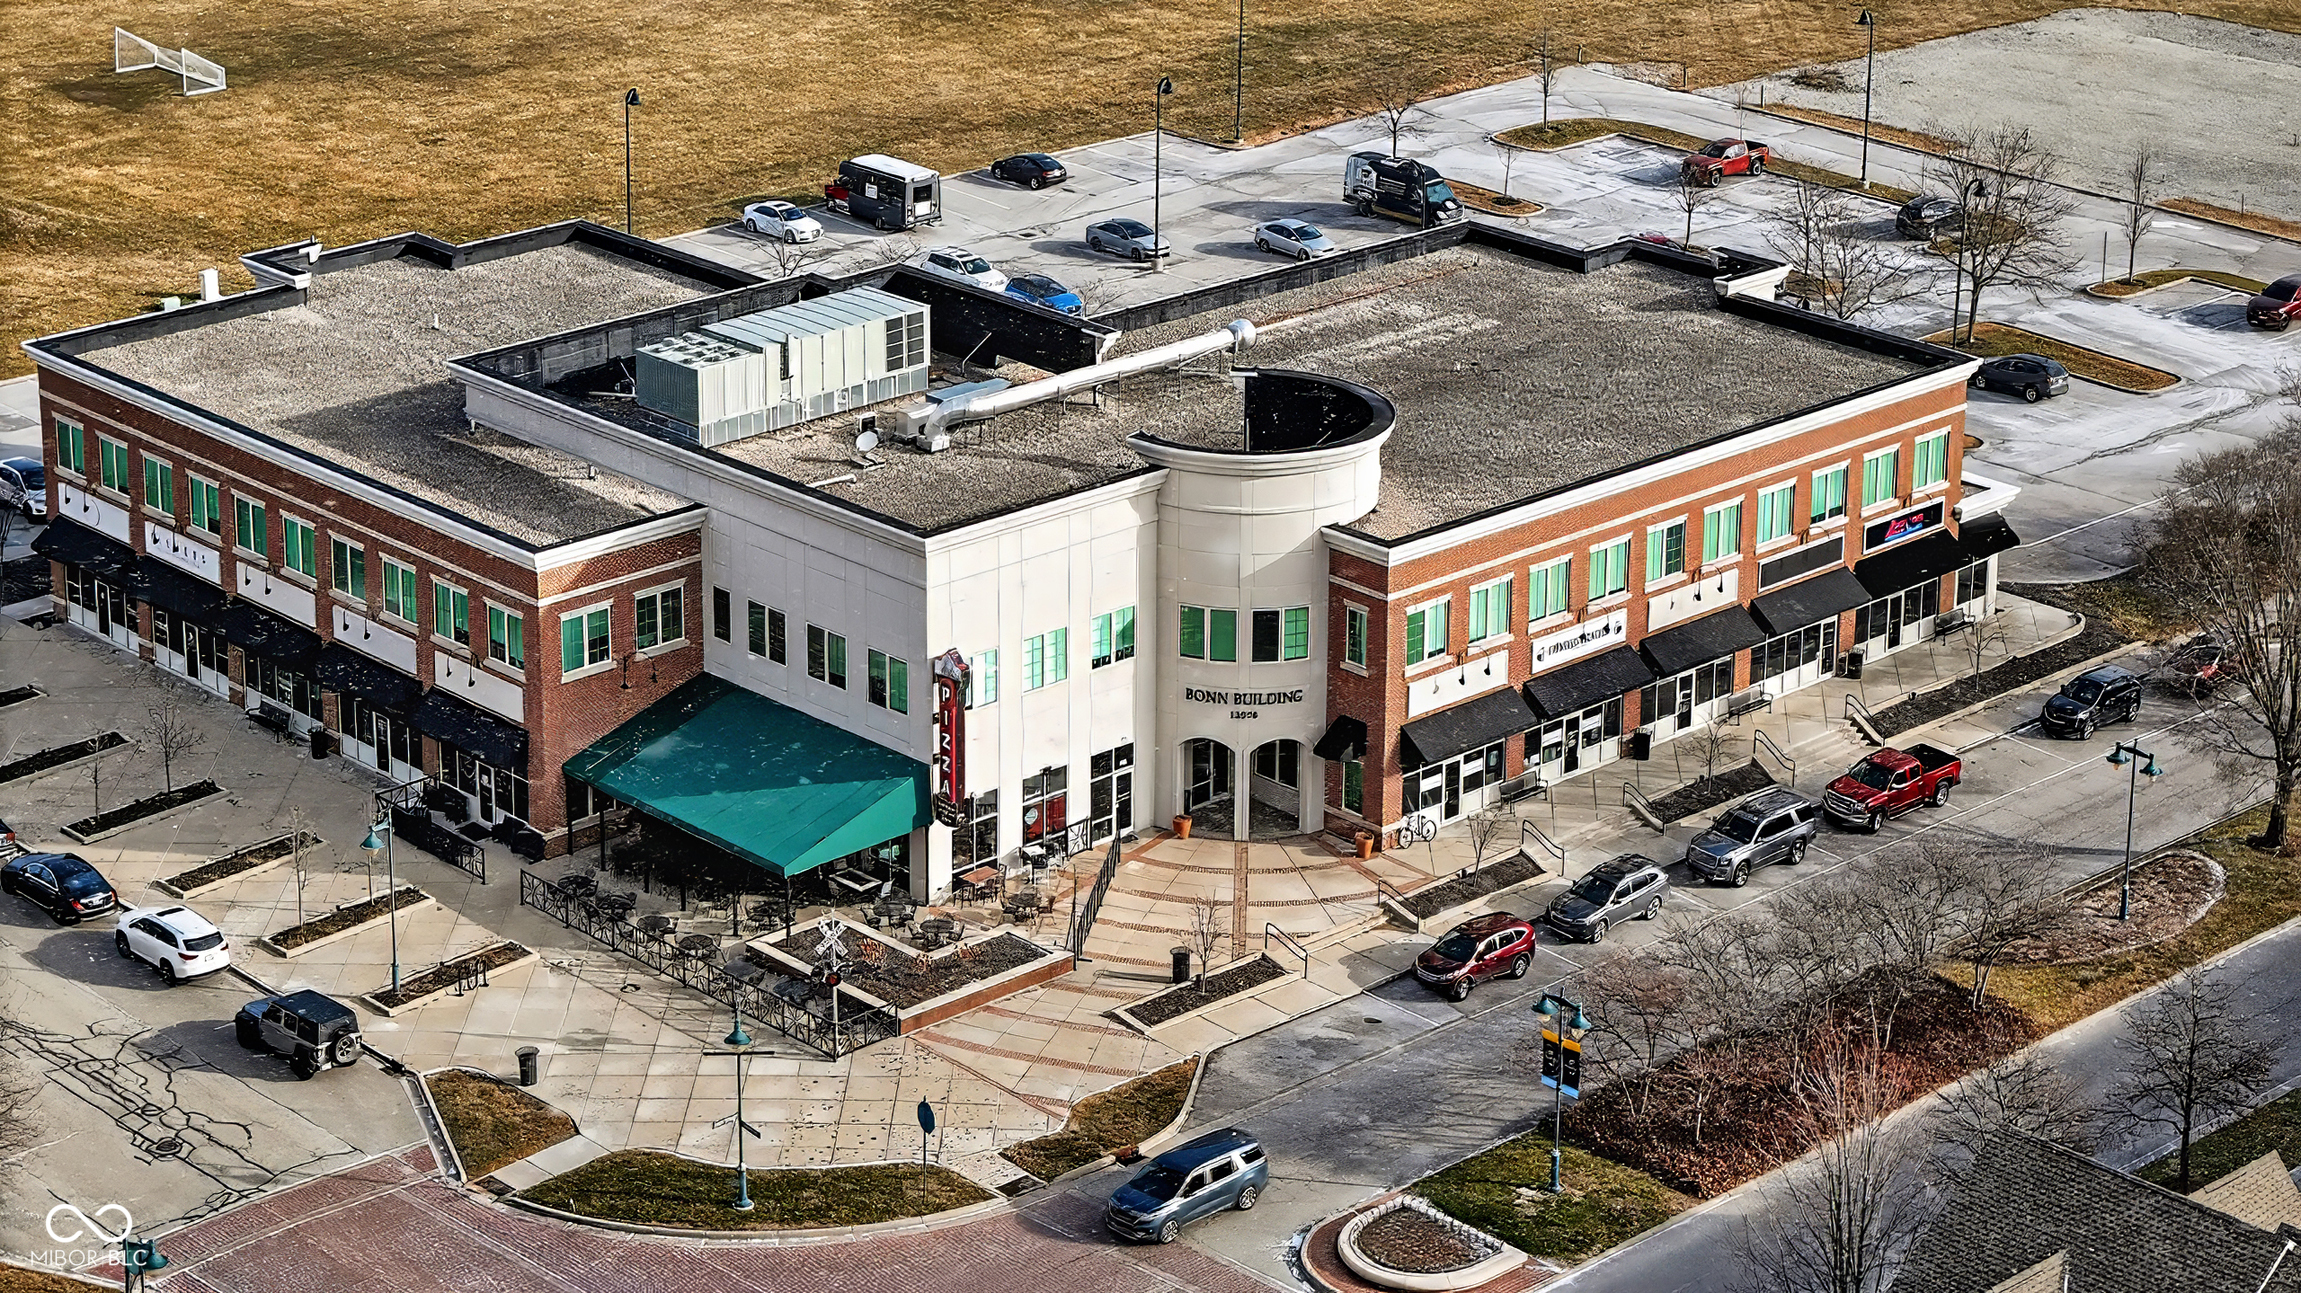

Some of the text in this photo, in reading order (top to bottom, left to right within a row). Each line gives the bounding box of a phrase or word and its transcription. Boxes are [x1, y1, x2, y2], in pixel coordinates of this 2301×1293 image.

[1185, 688, 1303, 705] BONN BUILDING
[941, 687, 951, 796] PIZZA
